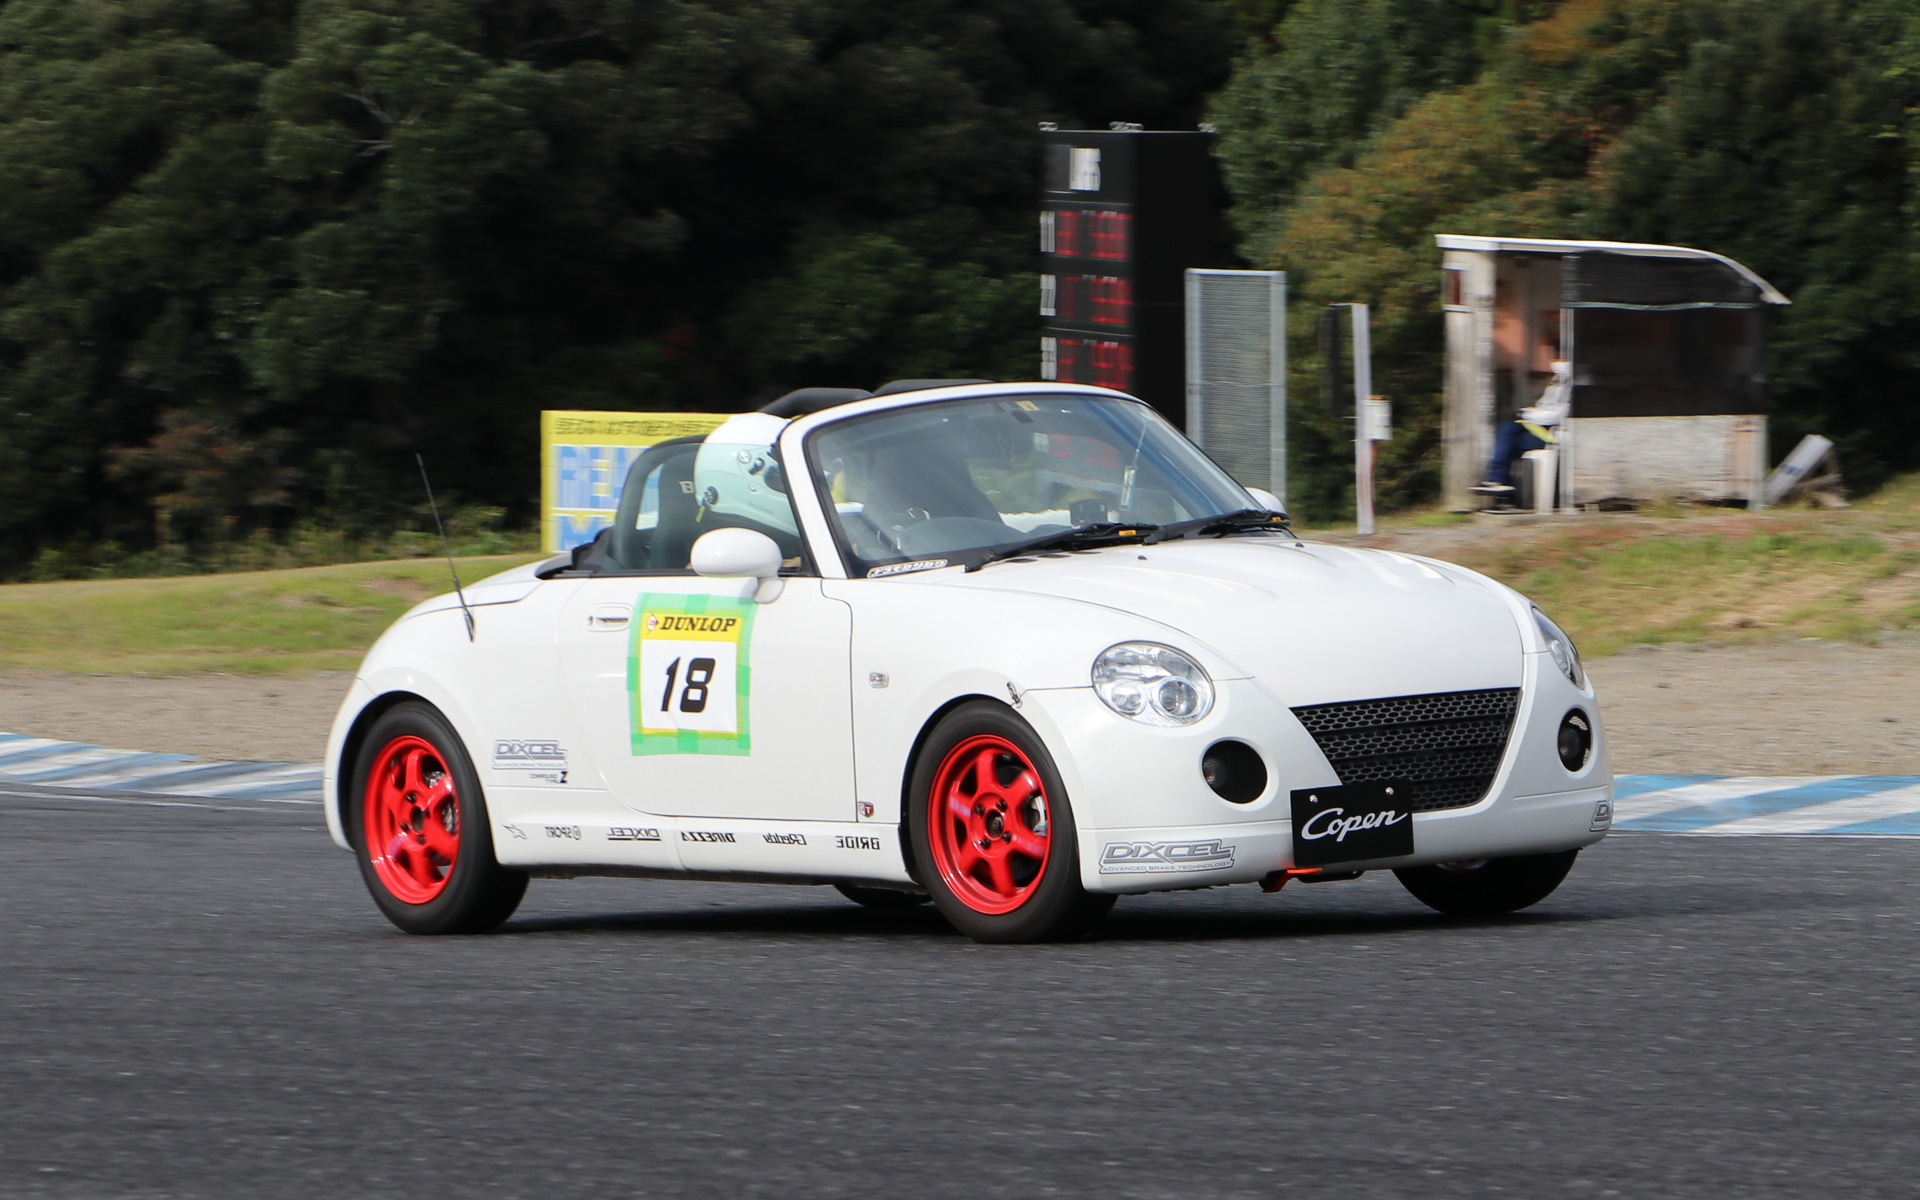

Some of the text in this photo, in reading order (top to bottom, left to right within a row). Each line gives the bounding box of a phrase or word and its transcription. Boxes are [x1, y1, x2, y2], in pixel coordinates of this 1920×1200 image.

[660, 616, 737, 632] DUNLOP
[660, 656, 716, 713] 18
[496, 742, 566, 758] DIXCEL
[1301, 807, 1408, 842] Copen
[1105, 842, 1232, 861] DIXCEL
[1178, 860, 1232, 870] TECHNOLOGY
